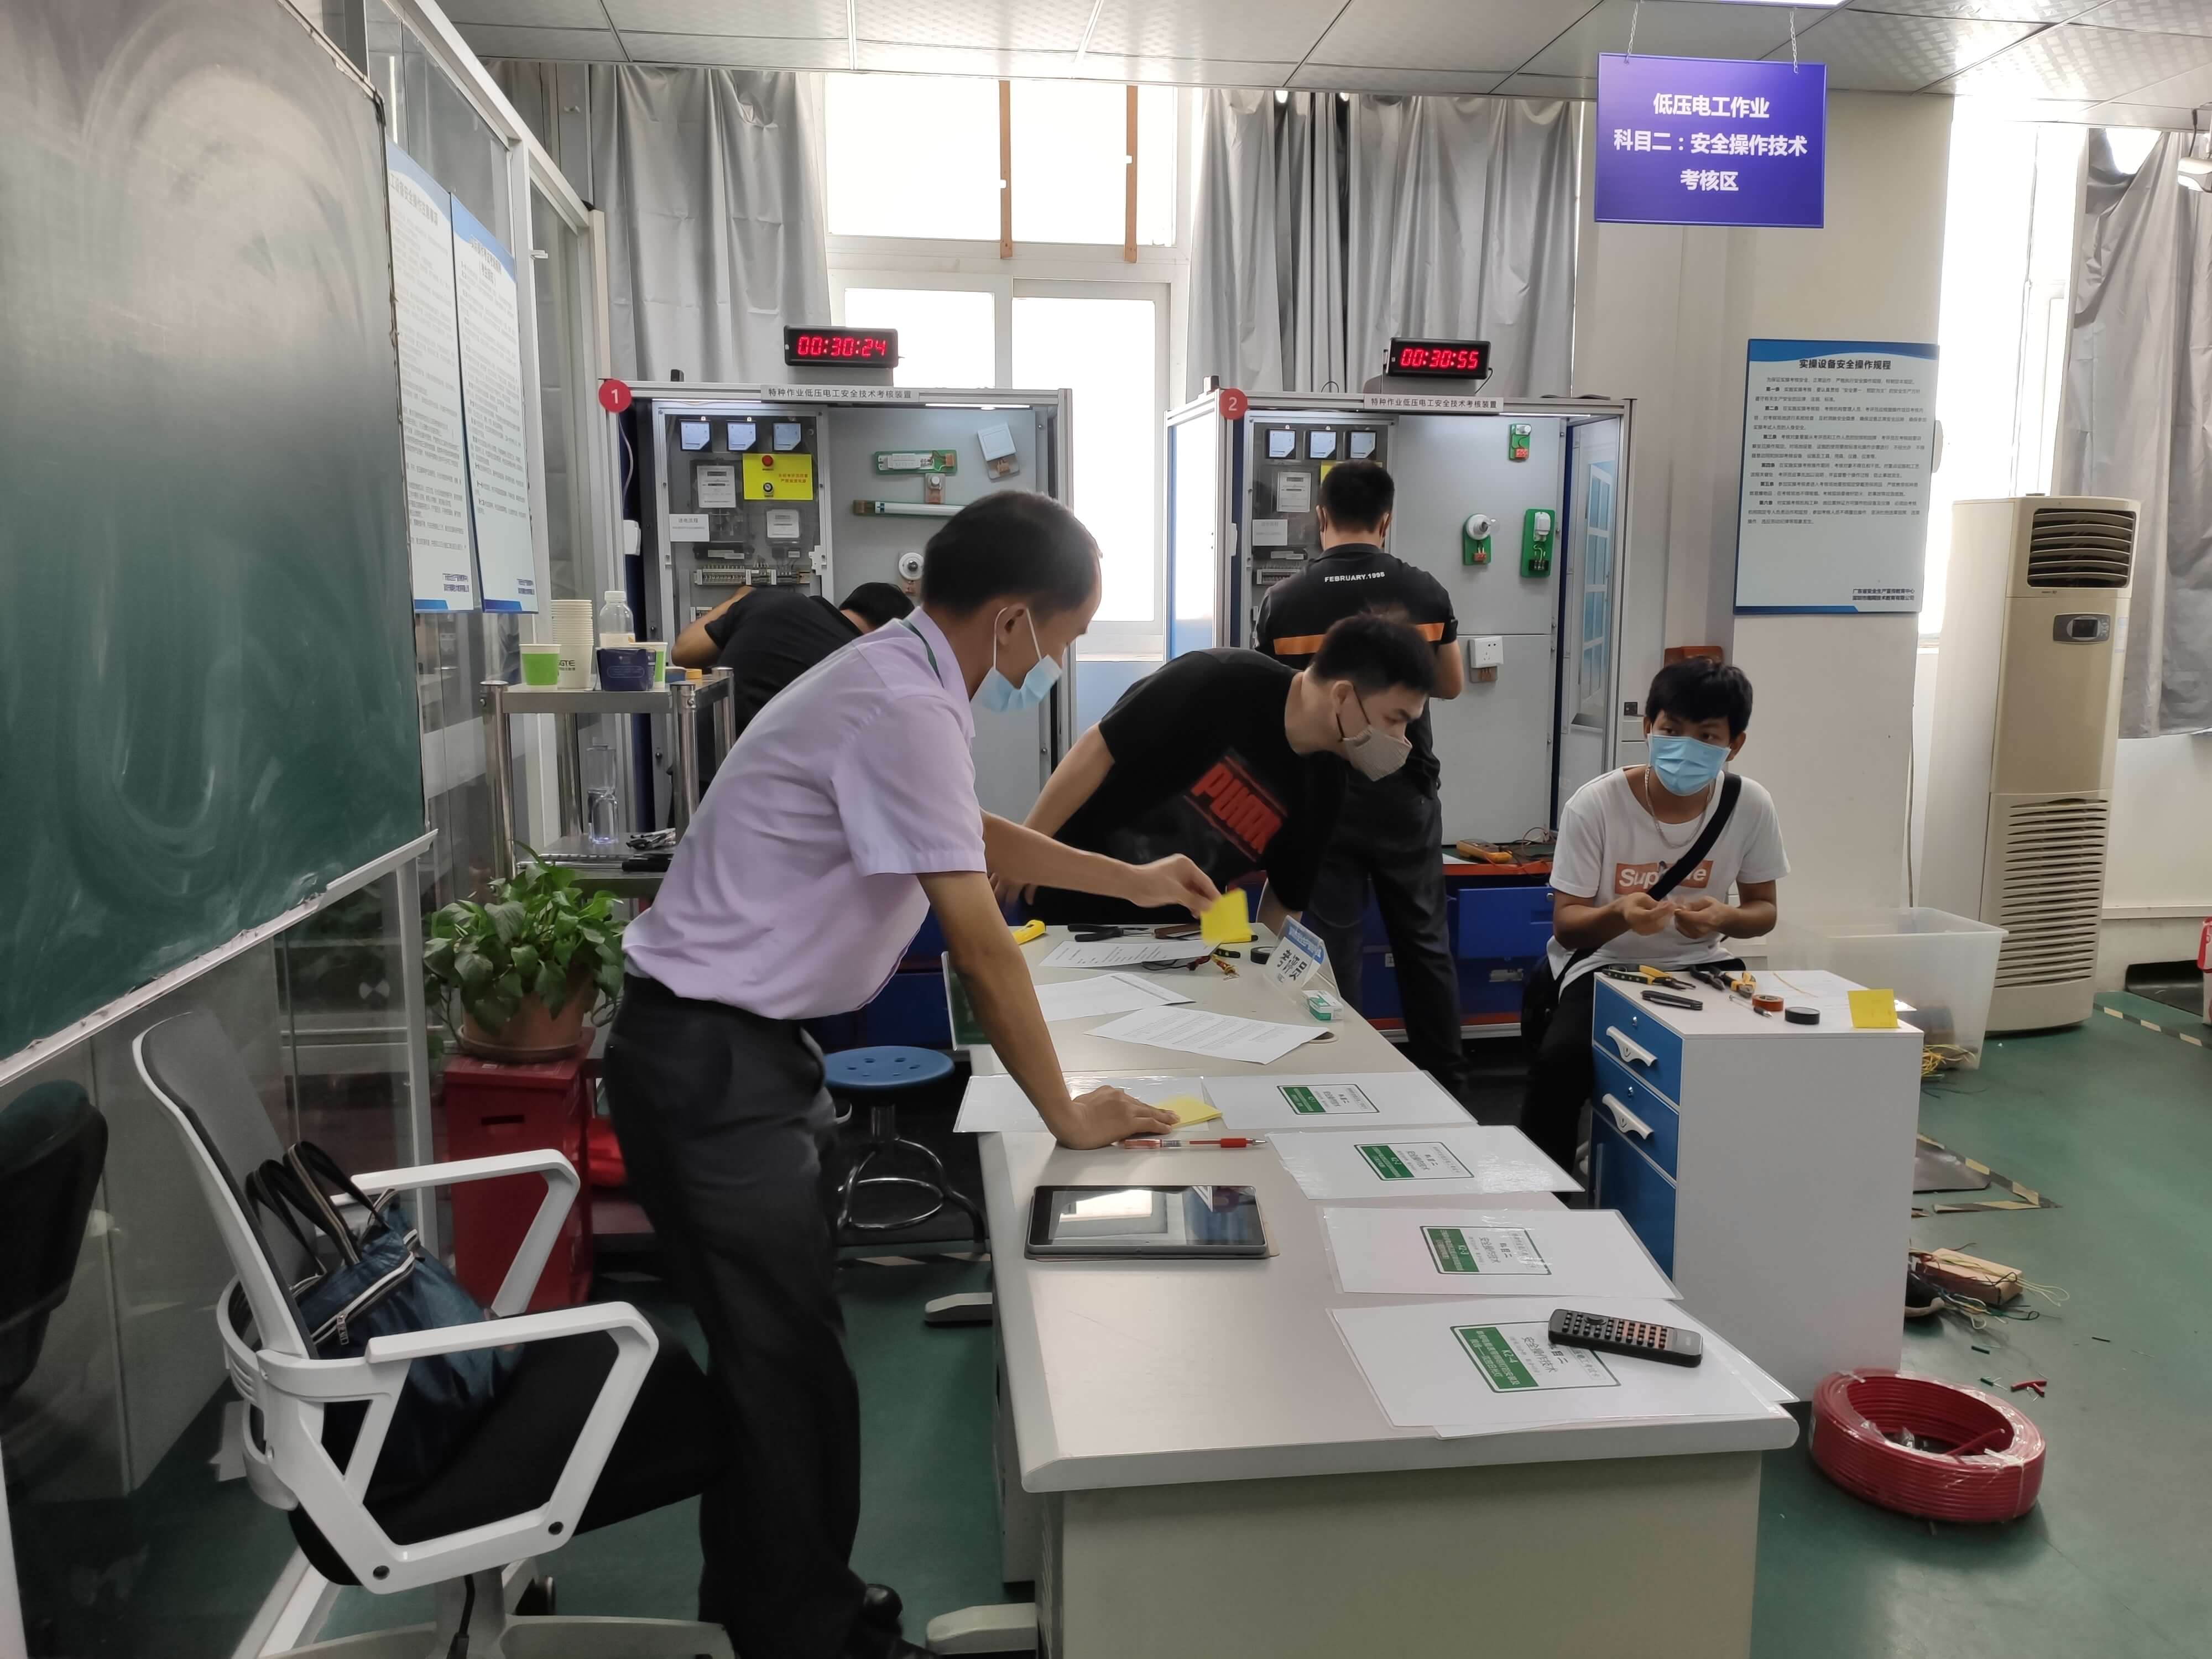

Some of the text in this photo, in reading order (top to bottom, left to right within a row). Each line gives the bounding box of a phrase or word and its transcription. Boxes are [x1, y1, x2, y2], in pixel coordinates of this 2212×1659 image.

[1653, 93, 1770, 118] 低压电工作业
[1614, 129, 1808, 156] 科目二：安全操作技术
[1680, 169, 1739, 191] 考核区
[798, 336, 886, 356] 00:30:24
[1401, 348, 1479, 368] 00:30:55
[1799, 359, 1892, 370] 实操设备安全操作规程
[611, 389, 618, 404] 1
[768, 388, 911, 399] 特种作业低压电工安全技术考核装置
[1371, 398, 1497, 408] 特种作业低压电工安全技术考核装置
[1228, 397, 1237, 411] 2
[1619, 868, 1707, 890] Supe
